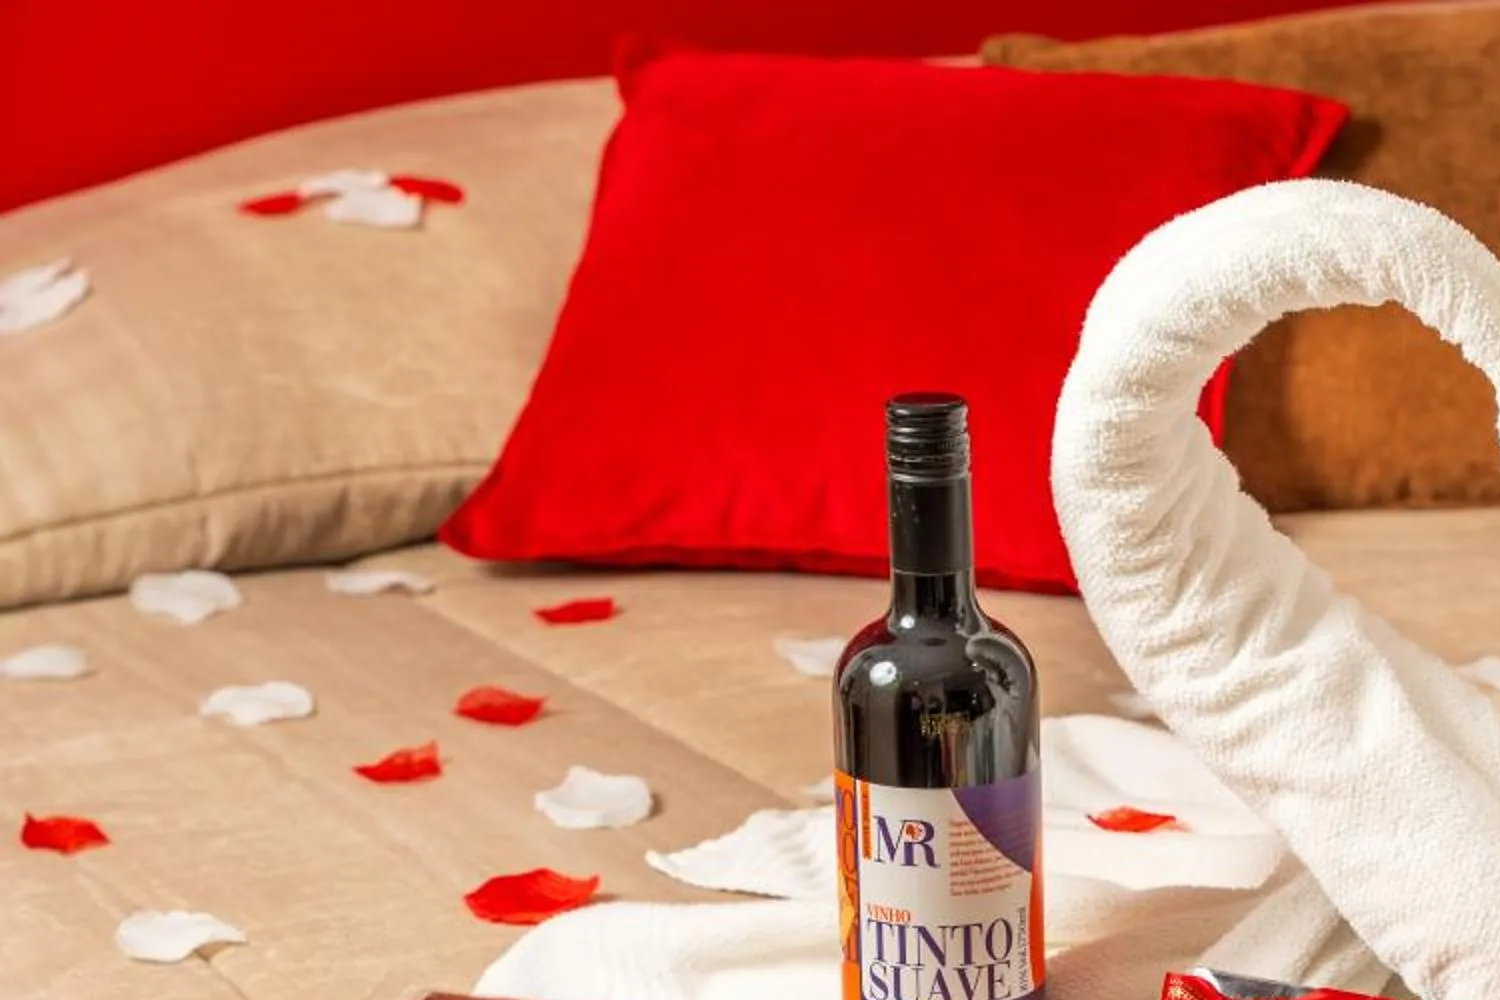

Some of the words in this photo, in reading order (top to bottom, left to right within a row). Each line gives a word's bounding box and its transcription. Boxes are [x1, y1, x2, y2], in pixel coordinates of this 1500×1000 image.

[873, 815, 941, 869] MR
[867, 903, 911, 923] VINHO
[867, 917, 1013, 967] TINTO
